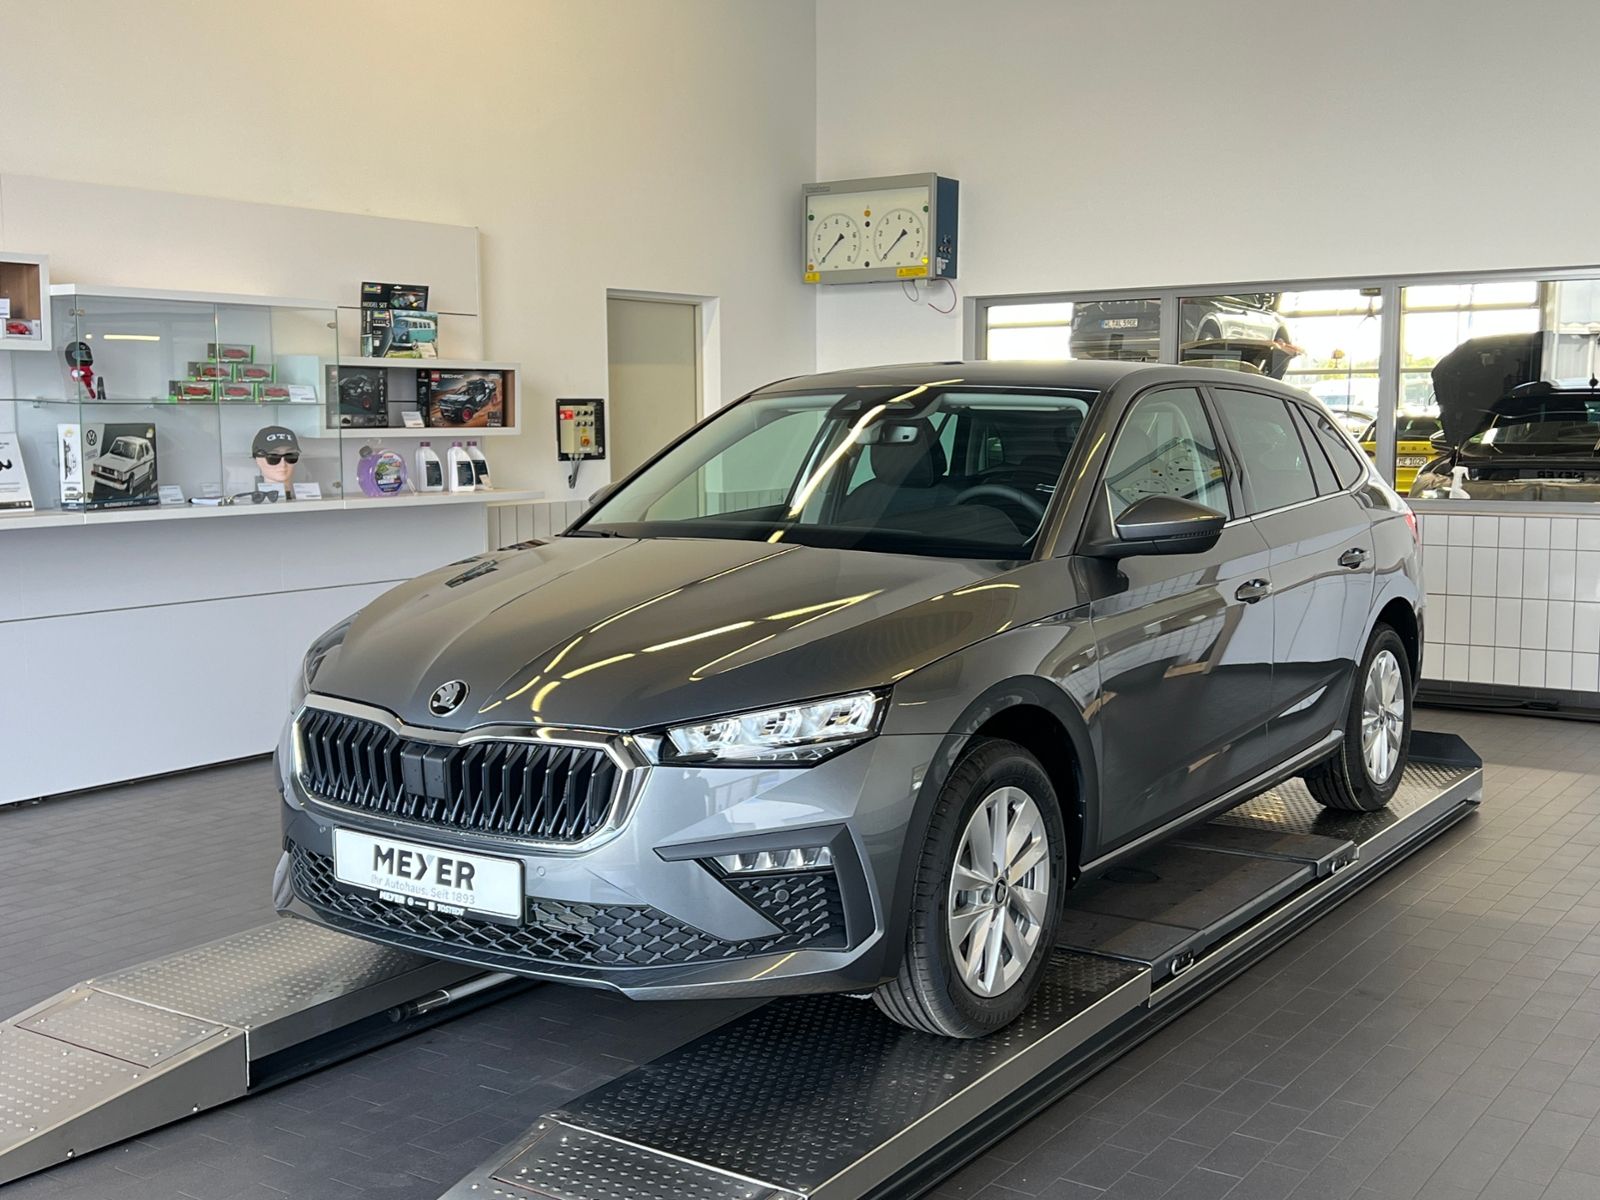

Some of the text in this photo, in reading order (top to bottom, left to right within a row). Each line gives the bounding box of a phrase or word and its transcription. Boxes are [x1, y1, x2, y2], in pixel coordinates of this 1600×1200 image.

[266, 433, 293, 442] GTI
[373, 844, 476, 891] MEYER
[371, 874, 383, 885] Ihr
[430, 887, 449, 900] Seit
[452, 891, 476, 905] 1893
